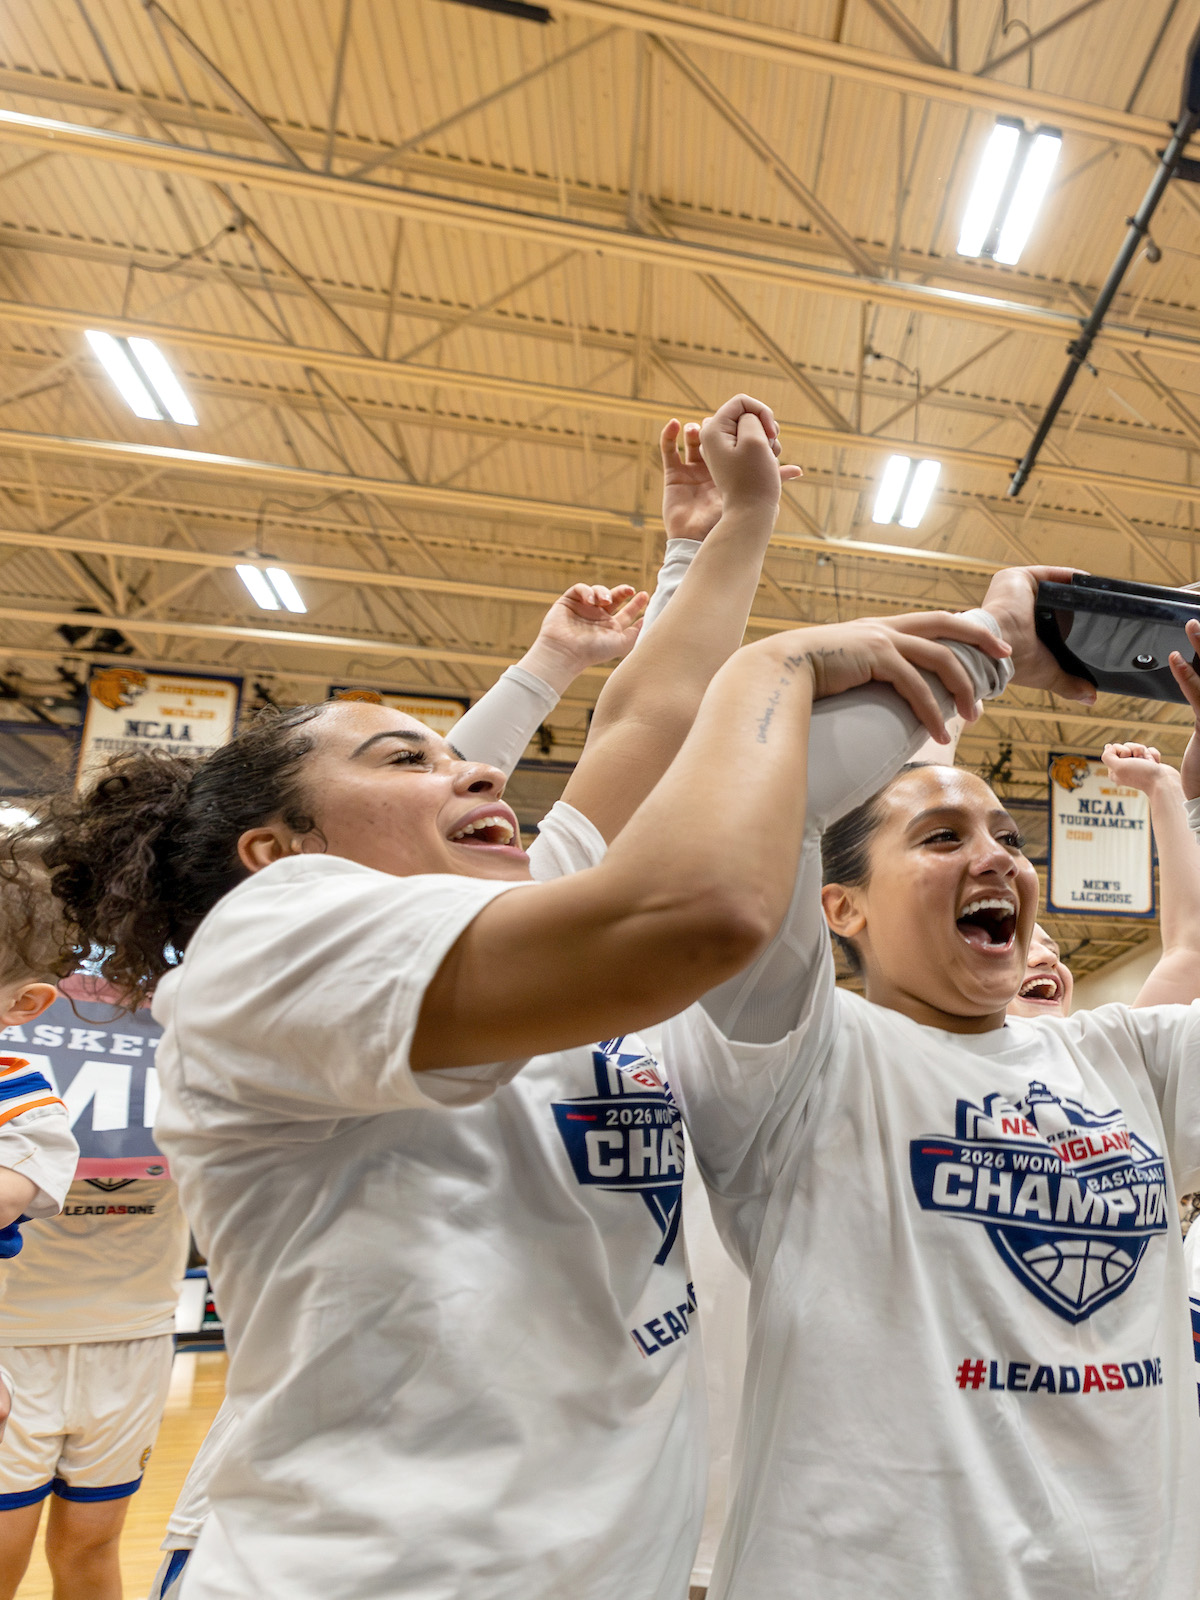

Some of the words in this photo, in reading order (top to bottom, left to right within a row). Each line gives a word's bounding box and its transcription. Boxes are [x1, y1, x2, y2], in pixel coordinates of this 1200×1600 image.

[125, 720, 191, 741] NCAA
[1078, 798, 1125, 816] NCAA
[1059, 814, 1144, 830] TOURNAMENT
[1083, 880, 1120, 890] MEN'S
[1071, 891, 1132, 904] LACROSSE
[606, 1108, 652, 1126] 2026
[1001, 1117, 1038, 1137] NE
[585, 1129, 684, 1178] CHA
[961, 1149, 1005, 1169] 2026
[62, 1205, 156, 1216] LEADASONE
[956, 1357, 1163, 1394] #LEADASONE
